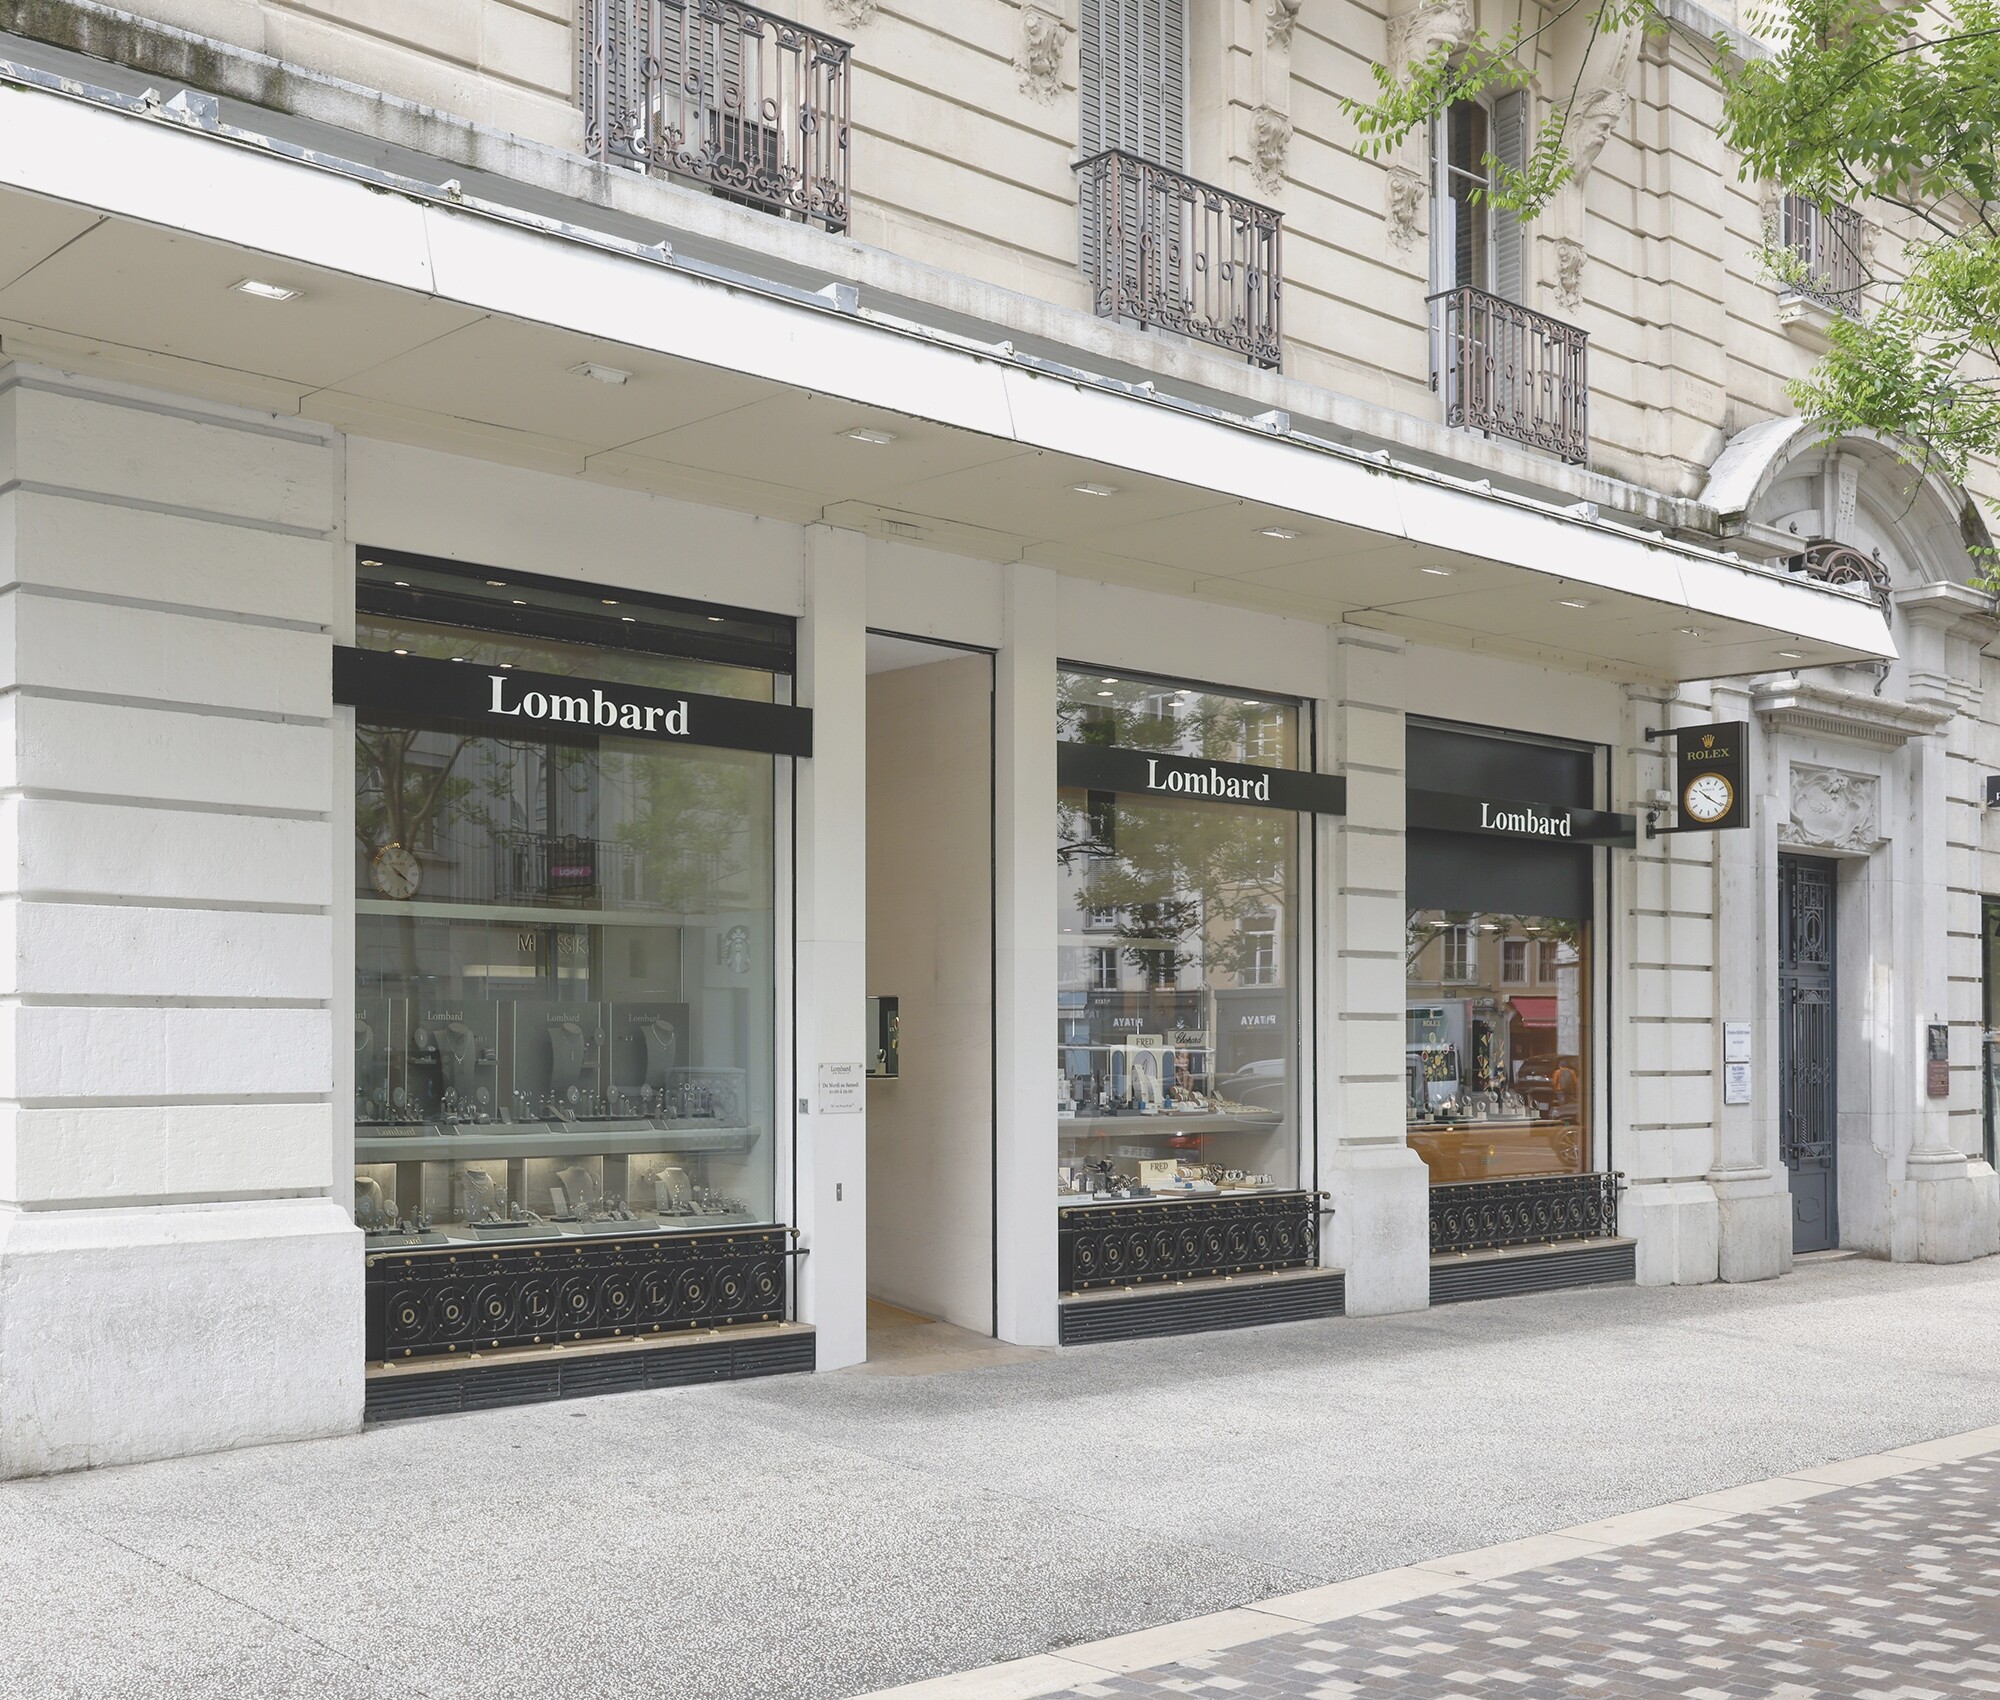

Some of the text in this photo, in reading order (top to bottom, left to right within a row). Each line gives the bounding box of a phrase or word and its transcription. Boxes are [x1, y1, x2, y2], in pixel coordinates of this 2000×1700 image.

[487, 675, 690, 735] Lombard
[1687, 749, 1729, 760] ROLEX
[1147, 759, 1270, 801] Lombard
[1480, 803, 1572, 837] Lombard
[427, 1011, 463, 1021] Lombard
[546, 1012, 580, 1022] Lombard
[628, 1013, 660, 1022] Lombard
[1136, 1038, 1155, 1048] FRED
[1150, 1162, 1169, 1172] FRED
